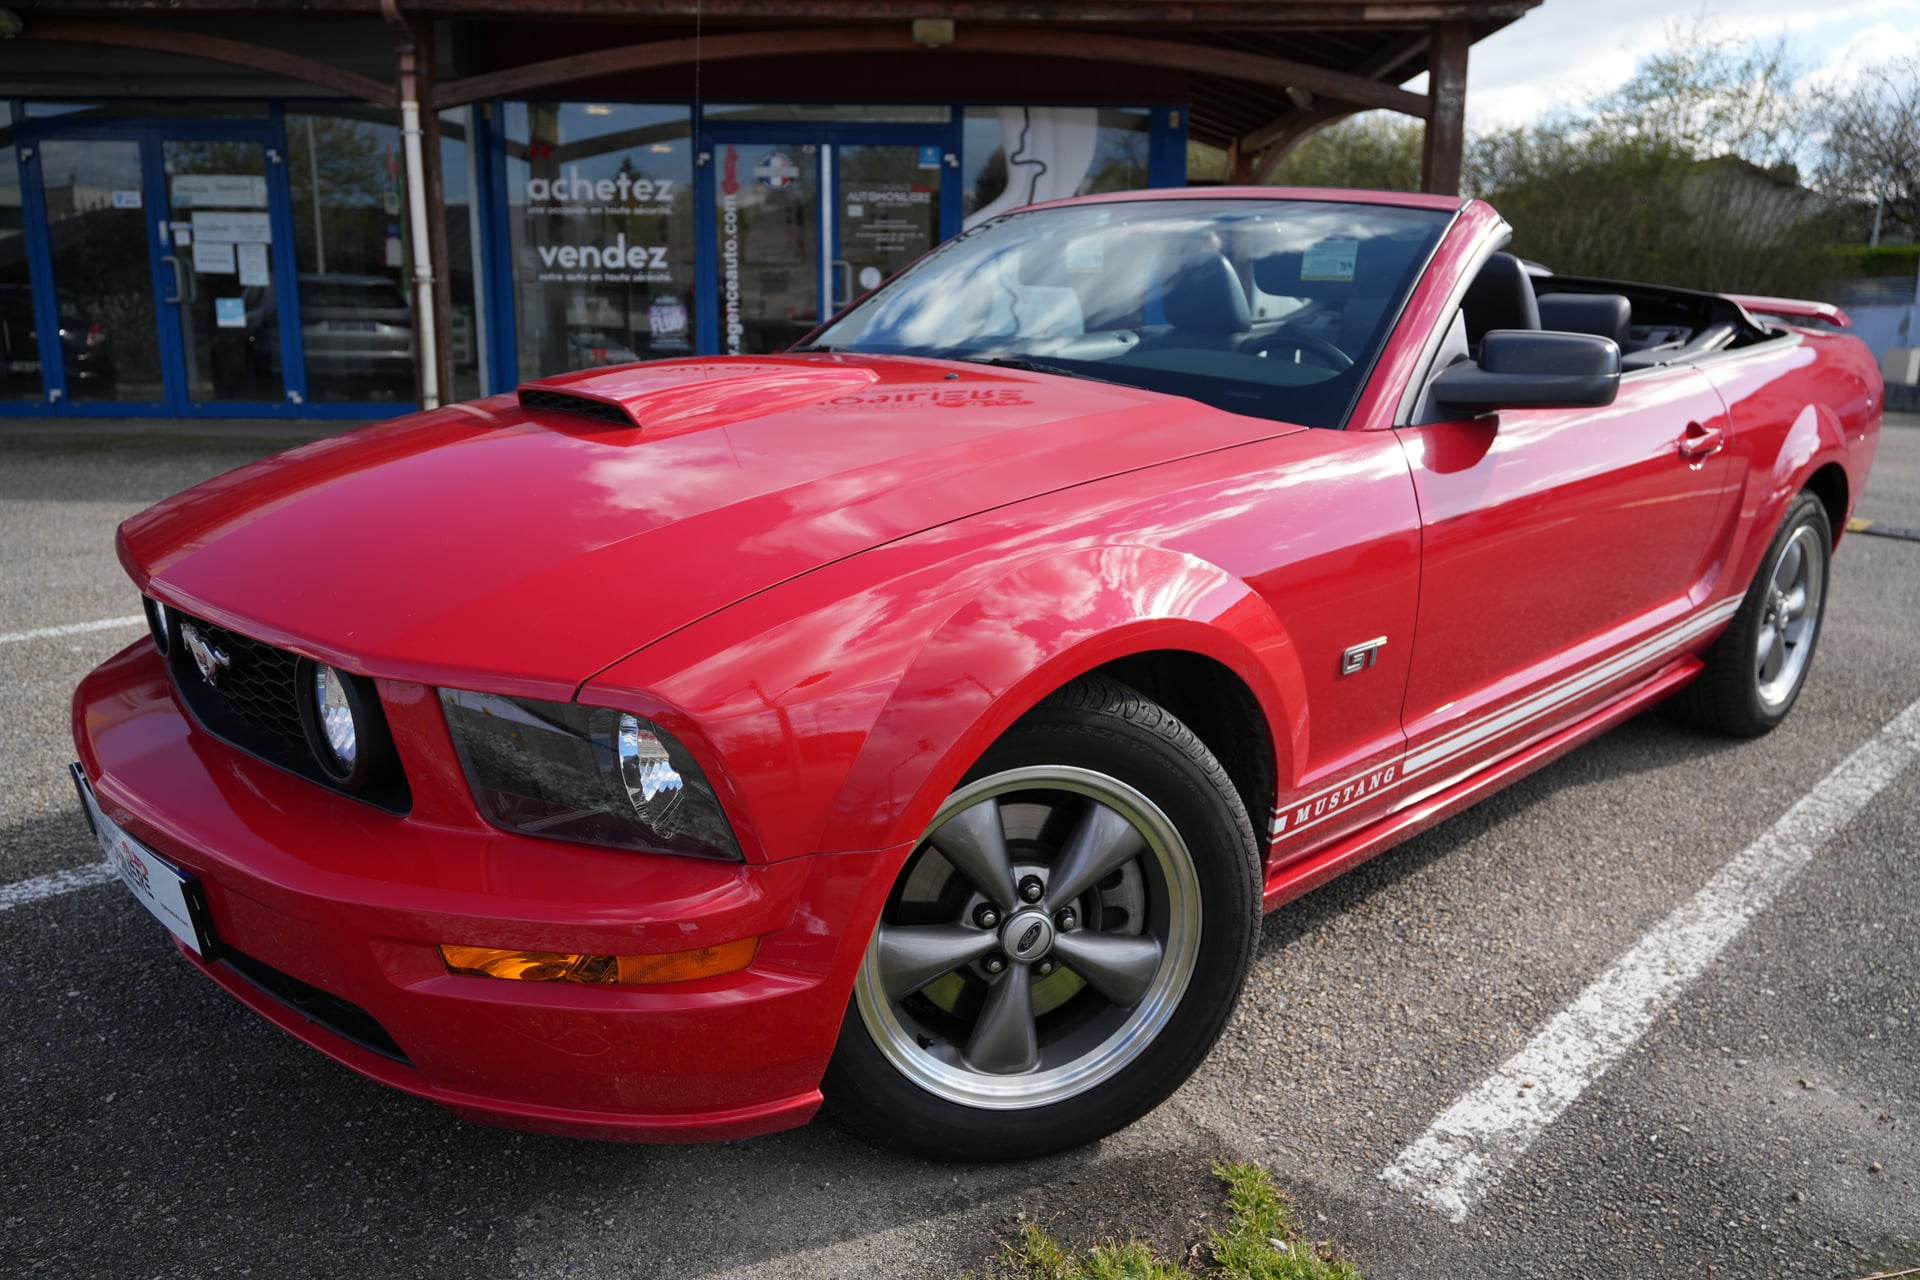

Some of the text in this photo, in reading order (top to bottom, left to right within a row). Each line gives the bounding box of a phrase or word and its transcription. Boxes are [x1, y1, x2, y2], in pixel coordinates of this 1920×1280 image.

[526, 164, 674, 202] achetez
[590, 206, 602, 215] en
[605, 205, 631, 215] toute
[537, 232, 669, 269] vendez
[539, 272, 564, 282] votre
[566, 272, 588, 282] auto
[590, 273, 603, 282] en
[605, 272, 631, 282] toute
[1341, 635, 1388, 676] GT
[1293, 766, 1396, 826] MUSTANG
